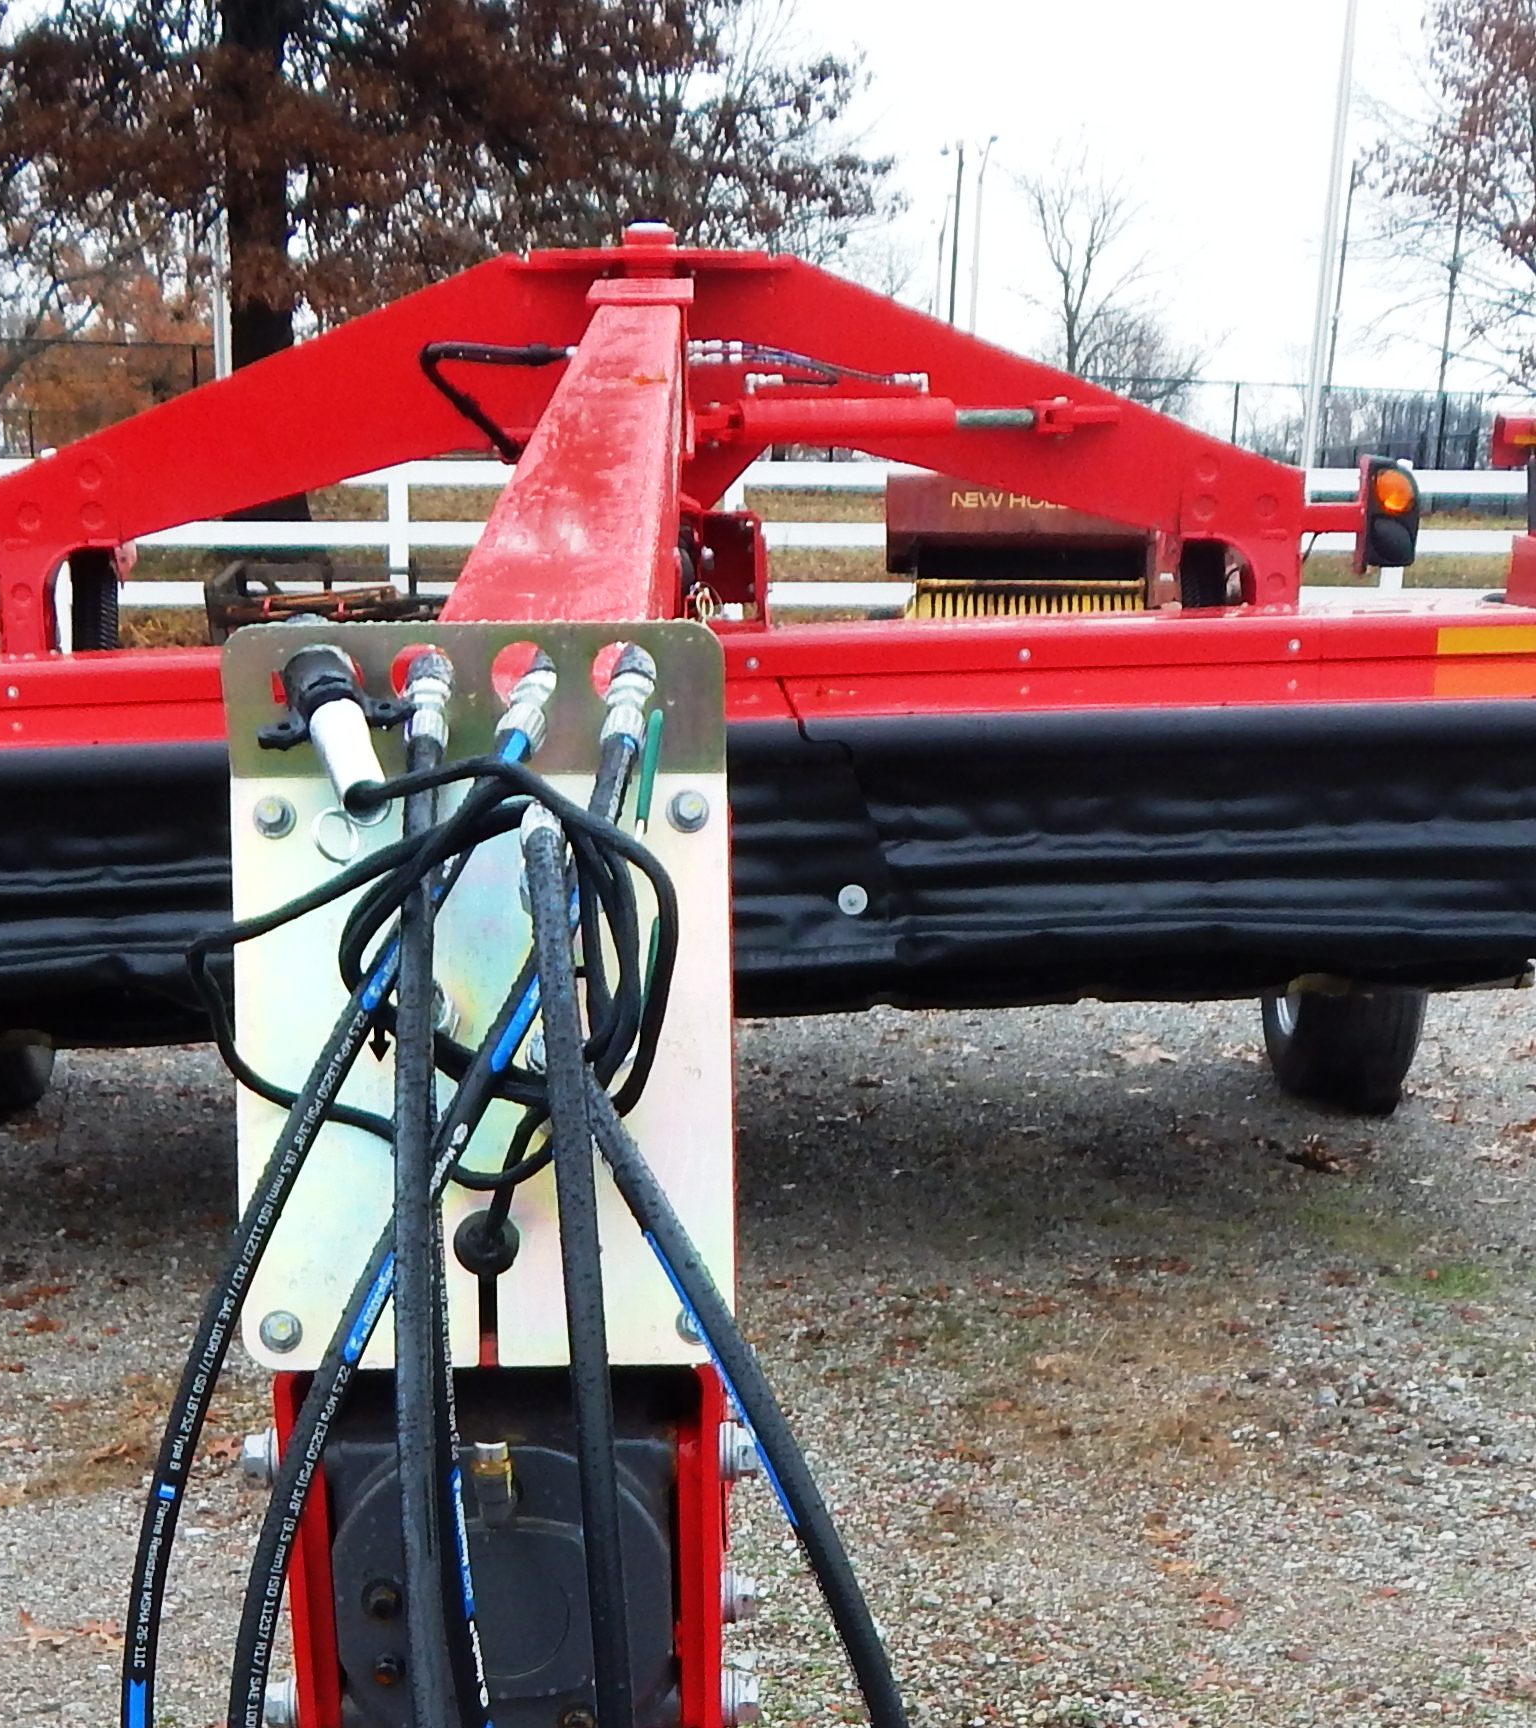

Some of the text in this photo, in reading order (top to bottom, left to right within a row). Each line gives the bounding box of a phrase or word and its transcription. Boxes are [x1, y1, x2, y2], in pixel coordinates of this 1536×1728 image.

[951, 491, 1004, 509] NEW
[257, 1200, 274, 1226] ISO
[241, 1225, 264, 1266] 11237
[231, 1263, 250, 1292] R17
[217, 1296, 236, 1321] SAE
[192, 1375, 208, 1395] ISO
[179, 1394, 201, 1434] 18752
[171, 1432, 190, 1461] Type
[169, 1460, 181, 1472] B
[152, 1499, 171, 1537] Flame
[142, 1535, 163, 1590] Resistant
[265, 1575, 281, 1598] ISO
[137, 1589, 153, 1625] MSHA
[258, 1599, 277, 1642] 11237
[133, 1624, 150, 1669] 2G-11C
[253, 1640, 268, 1667] R17
[247, 1674, 262, 1700] SAE
